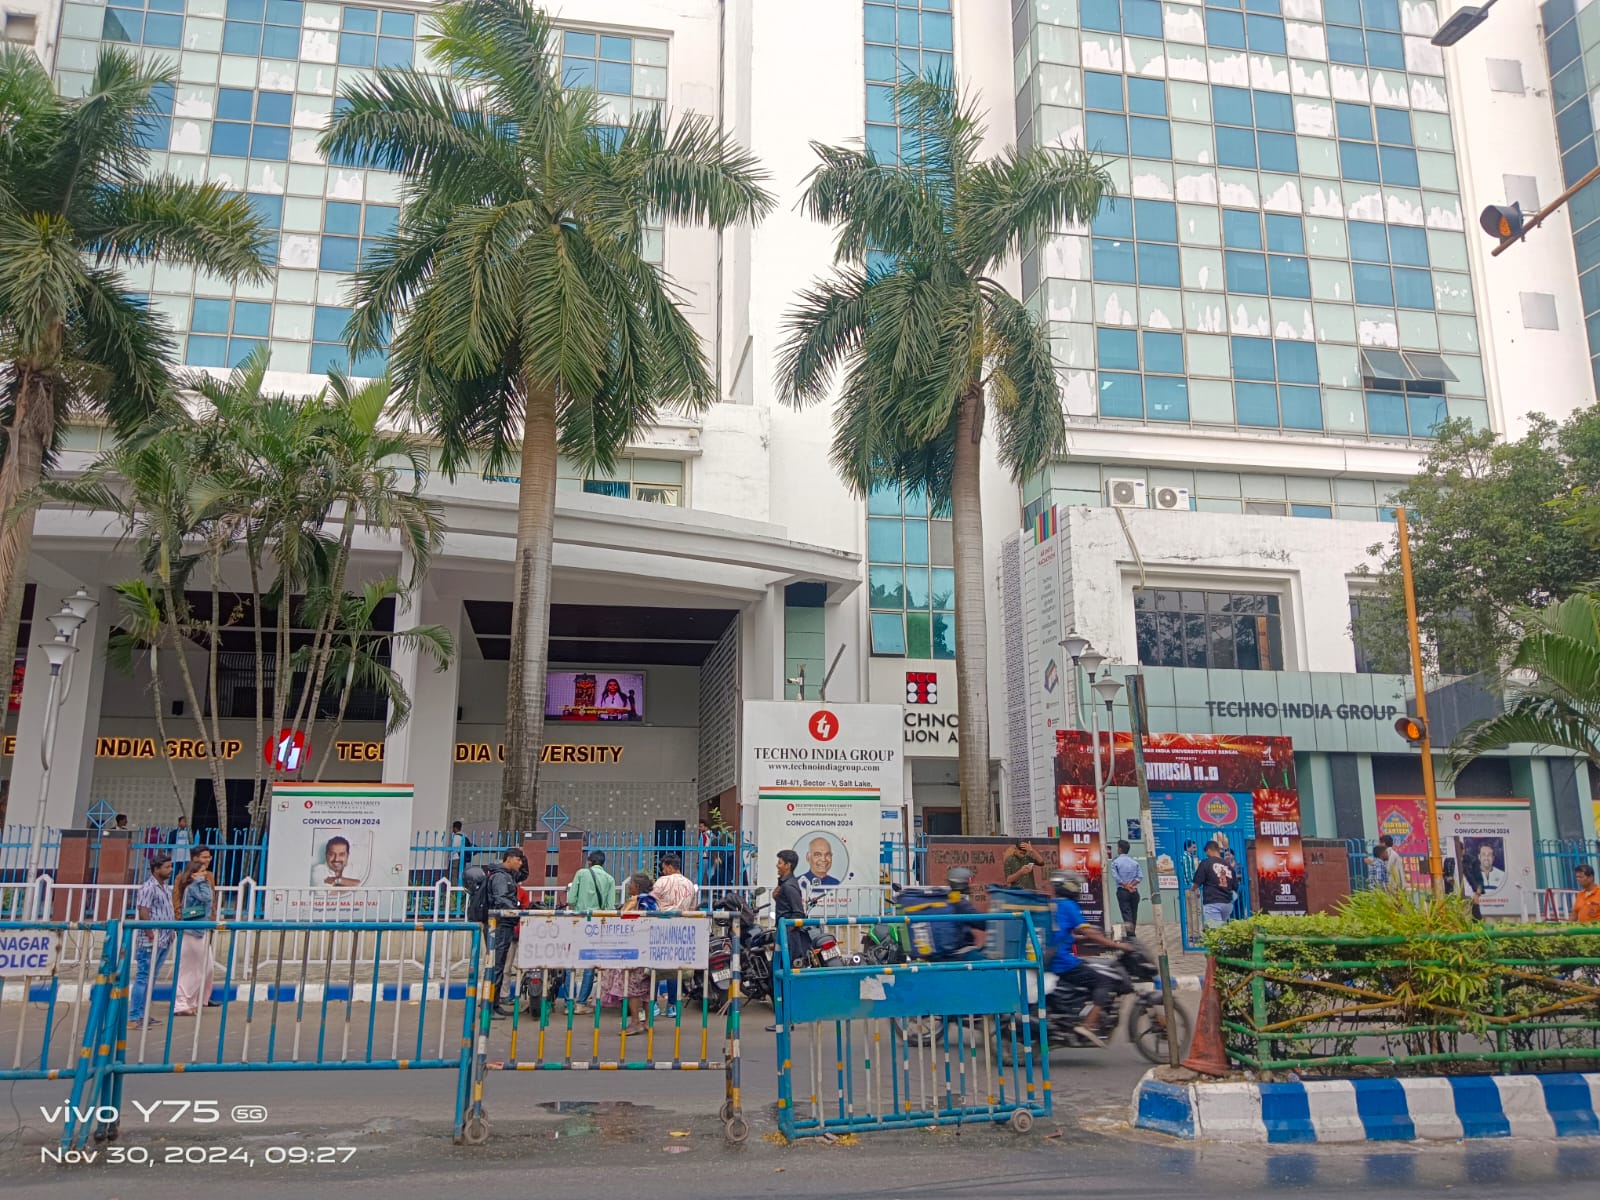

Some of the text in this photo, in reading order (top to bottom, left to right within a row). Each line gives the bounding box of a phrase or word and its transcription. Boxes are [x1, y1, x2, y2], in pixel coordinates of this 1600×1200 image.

[1205, 701, 1397, 721] TECHNO INDIA GROUP
[904, 730, 958, 743] LION A
[455, 744, 491, 761] DIA
[754, 747, 895, 762] TECHNO INDIA GROUP
[768, 762, 880, 773] www.technoindiagroup.com
[1145, 762, 1192, 781] NTHUSIA
[1260, 821, 1299, 836] ENTHUSIA
[1280, 883, 1292, 895] 30
[535, 923, 560, 939] GO
[523, 943, 572, 959] SLOW
[649, 947, 674, 961] TRAFFIC
[674, 947, 696, 961] POLICE
